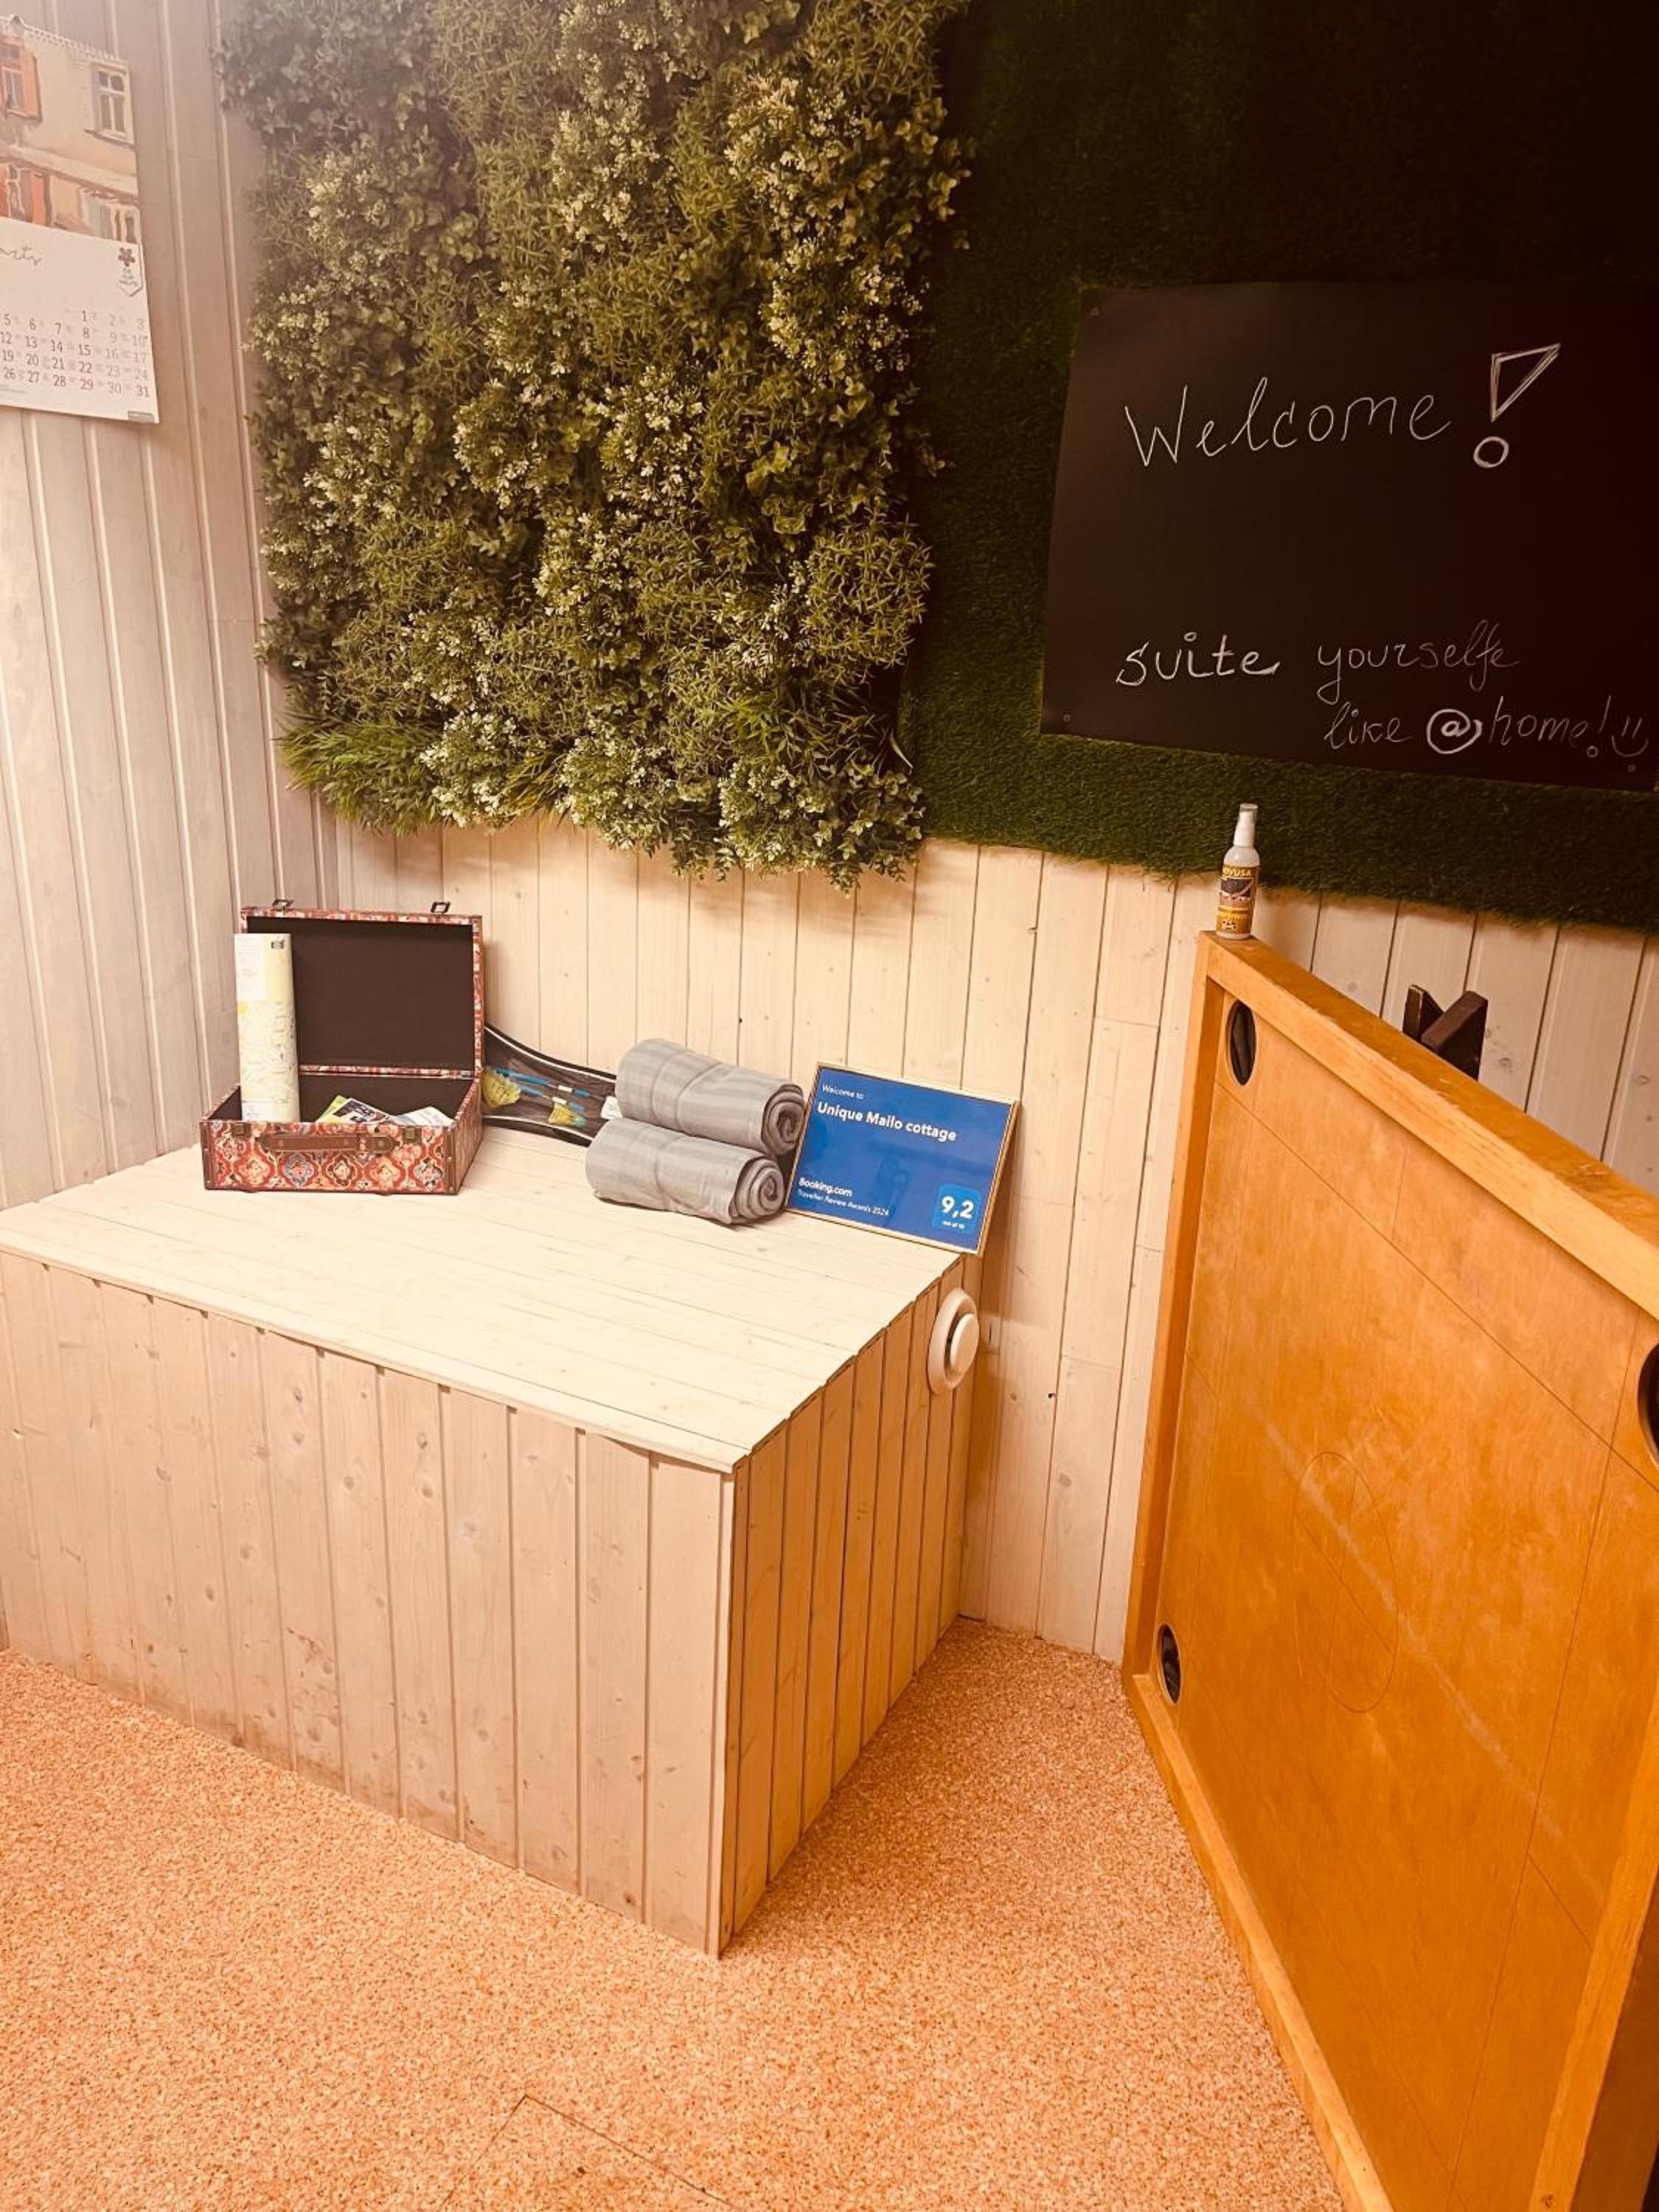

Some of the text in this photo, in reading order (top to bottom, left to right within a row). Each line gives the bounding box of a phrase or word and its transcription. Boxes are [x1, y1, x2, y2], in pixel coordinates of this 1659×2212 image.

[3, 313, 11, 326] 5
[29, 318, 36, 330] 6
[54, 321, 61, 335] 7
[82, 327, 89, 339] 8
[110, 331, 117, 343] 9
[82, 310, 87, 322] 1
[0, 331, 147, 364] 12 13 14 15 16 17
[2, 349, 147, 380] 19 20 21 22 23 24
[3, 366, 149, 398] 26 27 28 29 30 31
[1323, 695, 1413, 751] like
[821, 1084, 865, 1100] Welcome to
[817, 1101, 957, 1143] Unique Mailo cottage
[798, 1176, 854, 1198] Booking.com
[942, 1195, 975, 1220] 9,2
